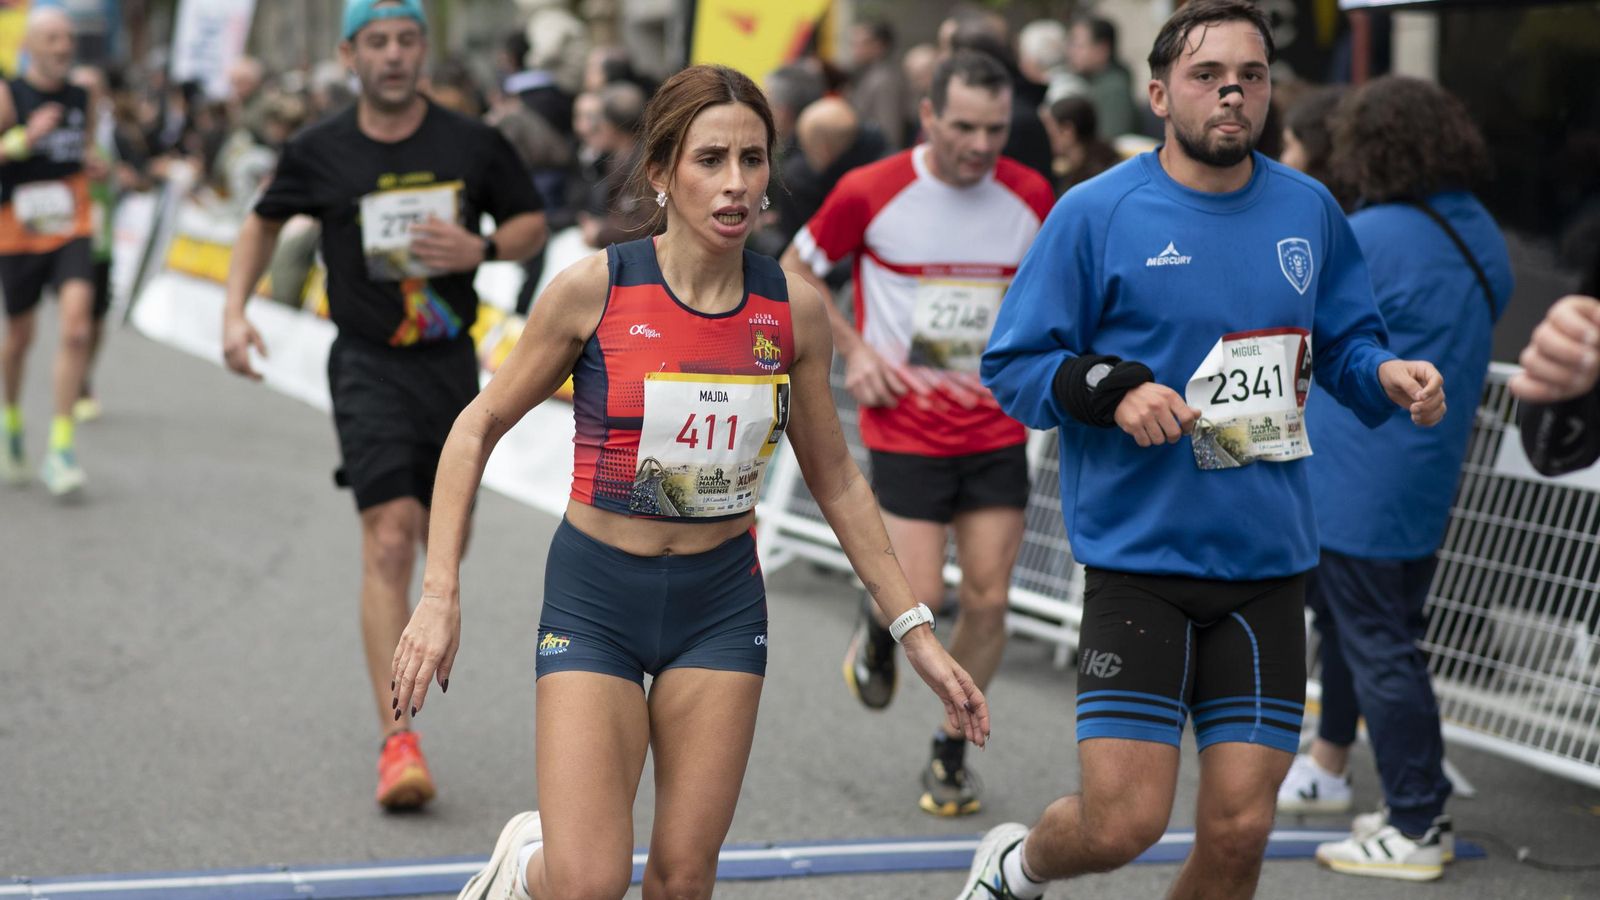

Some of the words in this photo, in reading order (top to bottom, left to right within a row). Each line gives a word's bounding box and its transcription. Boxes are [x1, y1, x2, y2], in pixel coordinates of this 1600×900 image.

[1146, 255, 1192, 267] MERCURY
[749, 318, 779, 326] OURENSE
[929, 303, 990, 329] 2748
[1231, 345, 1262, 358] MIGUEL
[1208, 364, 1283, 405] 2341
[699, 390, 729, 403] MAJDA
[676, 413, 738, 450] 411
